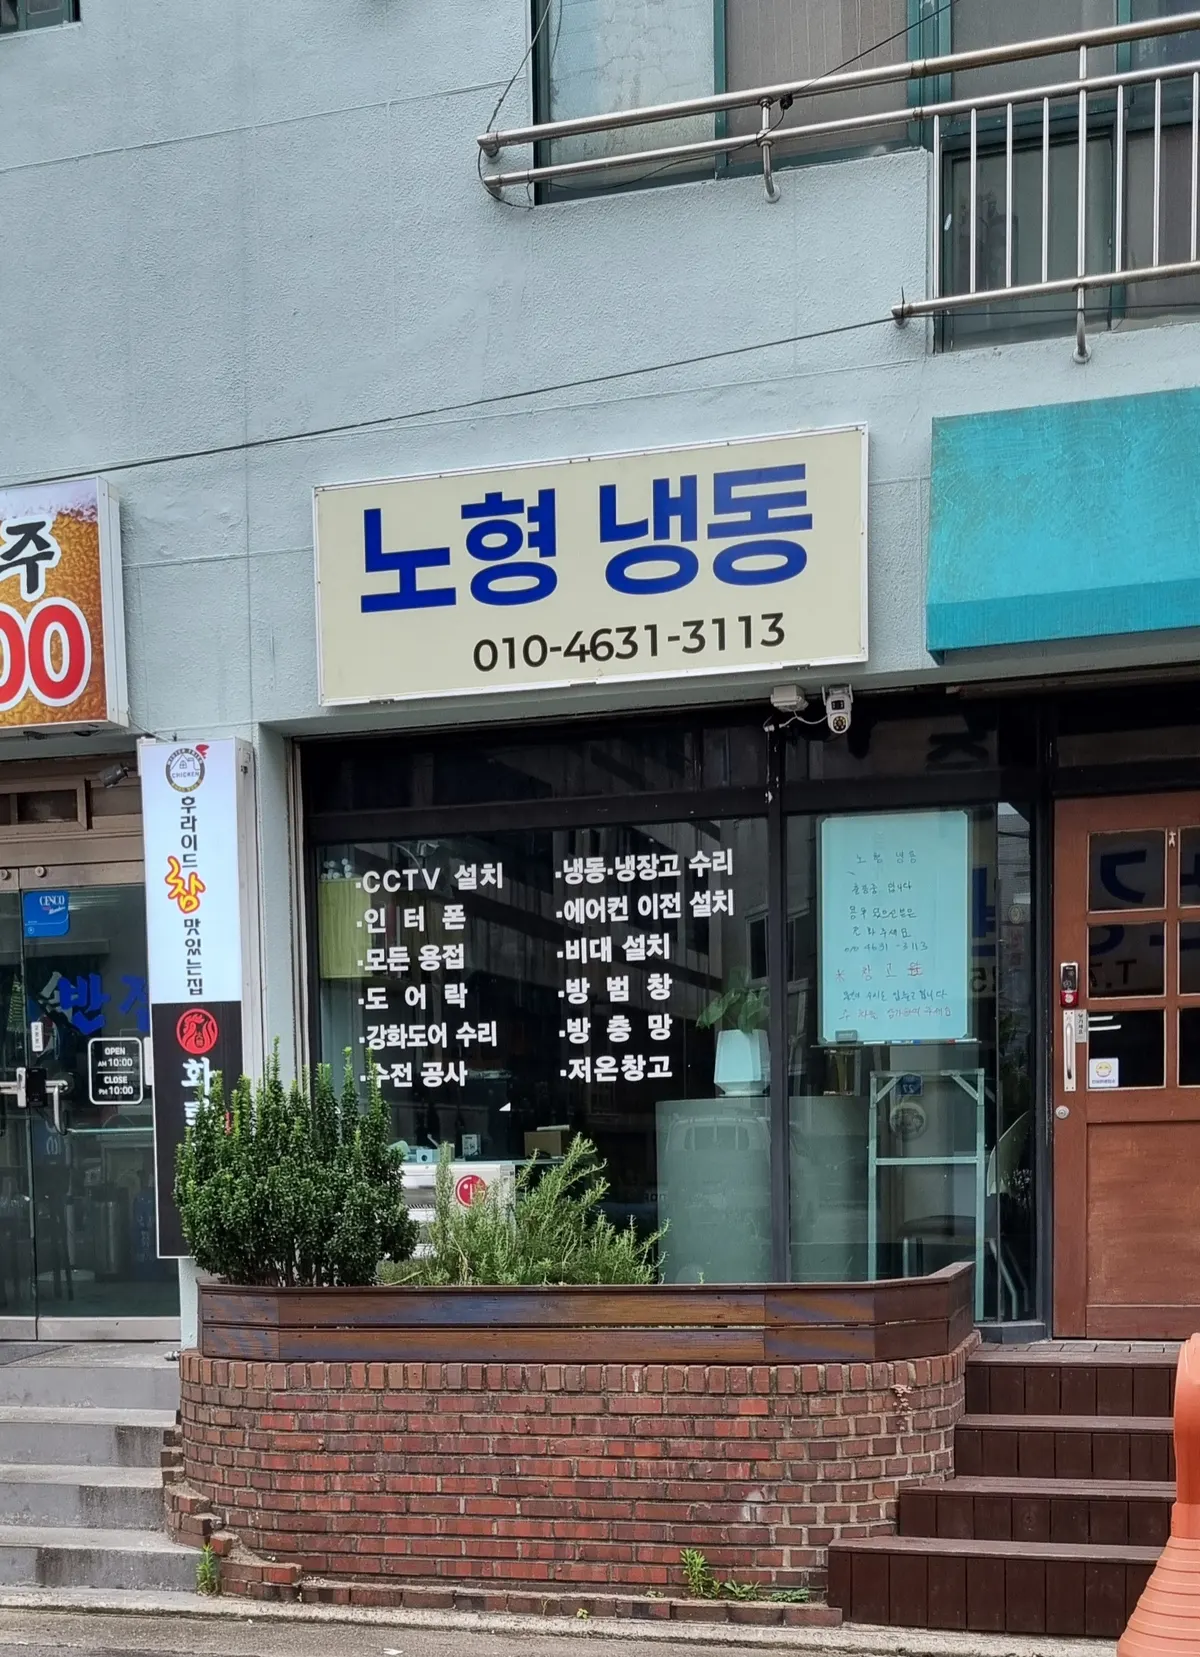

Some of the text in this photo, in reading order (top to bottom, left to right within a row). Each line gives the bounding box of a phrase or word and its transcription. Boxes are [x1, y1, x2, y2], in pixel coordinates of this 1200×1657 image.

[361, 464, 812, 613] 노형 냉동
[473, 612, 785, 672] 010-4631-3113
[180, 796, 198, 869] 후라이드
[689, 848, 733, 877] 수리
[362, 862, 503, 893] CCTV 설치
[887, 881, 912, 893] 입니다
[563, 889, 734, 924] 에어컨 이전 설치
[184, 918, 203, 996] 맛있는집
[365, 943, 465, 971] 모든 용접
[565, 933, 669, 964] 비대 설치
[366, 1021, 497, 1050] 강화도어 수리
[104, 1047, 126, 1055] OPEN
[108, 1058, 133, 1067] 10:00
[103, 1075, 128, 1084] CLOSE
[421, 1061, 468, 1087] 공사
[568, 1054, 673, 1083] 저온창고
[108, 1086, 134, 1095] 10:00
